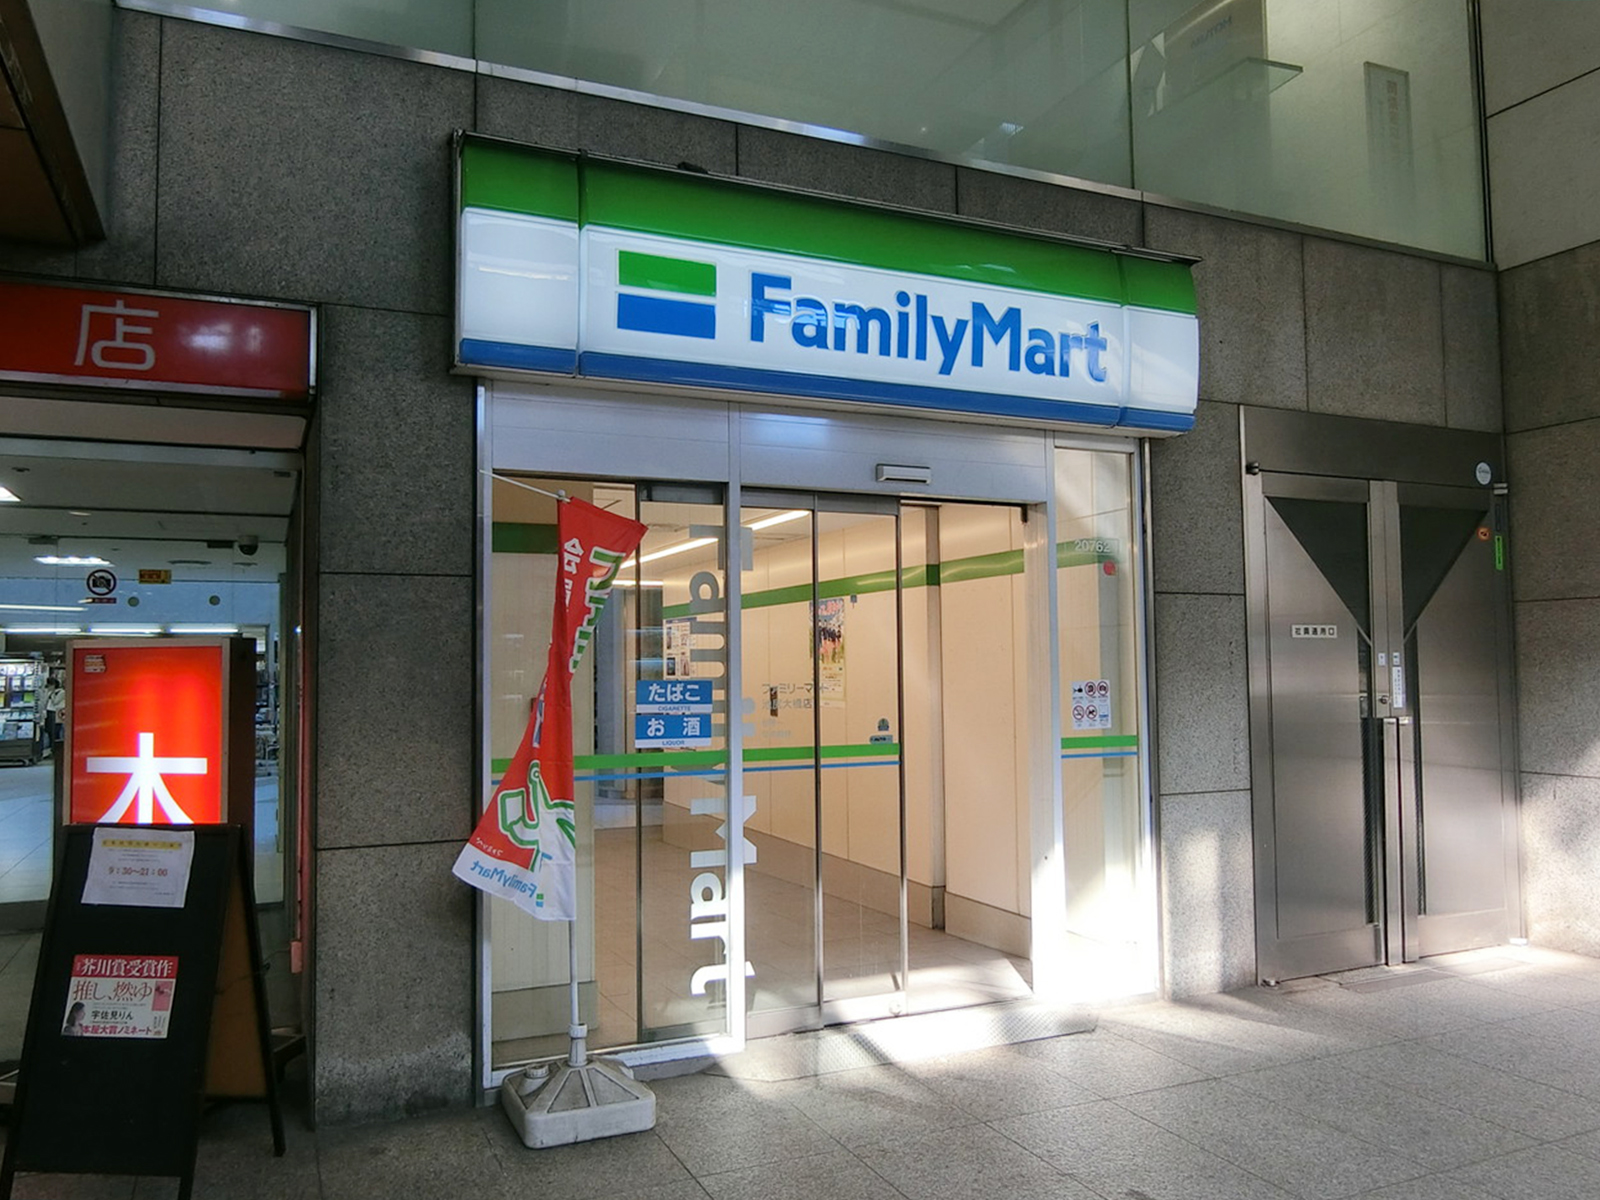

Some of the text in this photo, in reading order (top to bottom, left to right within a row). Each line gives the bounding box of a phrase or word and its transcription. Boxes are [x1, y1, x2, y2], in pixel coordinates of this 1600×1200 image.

[74, 300, 160, 371] 店
[750, 271, 1109, 383] FamilyMart
[1074, 539, 1112, 553] 20762
[648, 682, 702, 702] たばこ
[82, 959, 172, 977] 芥川賞受賞作
